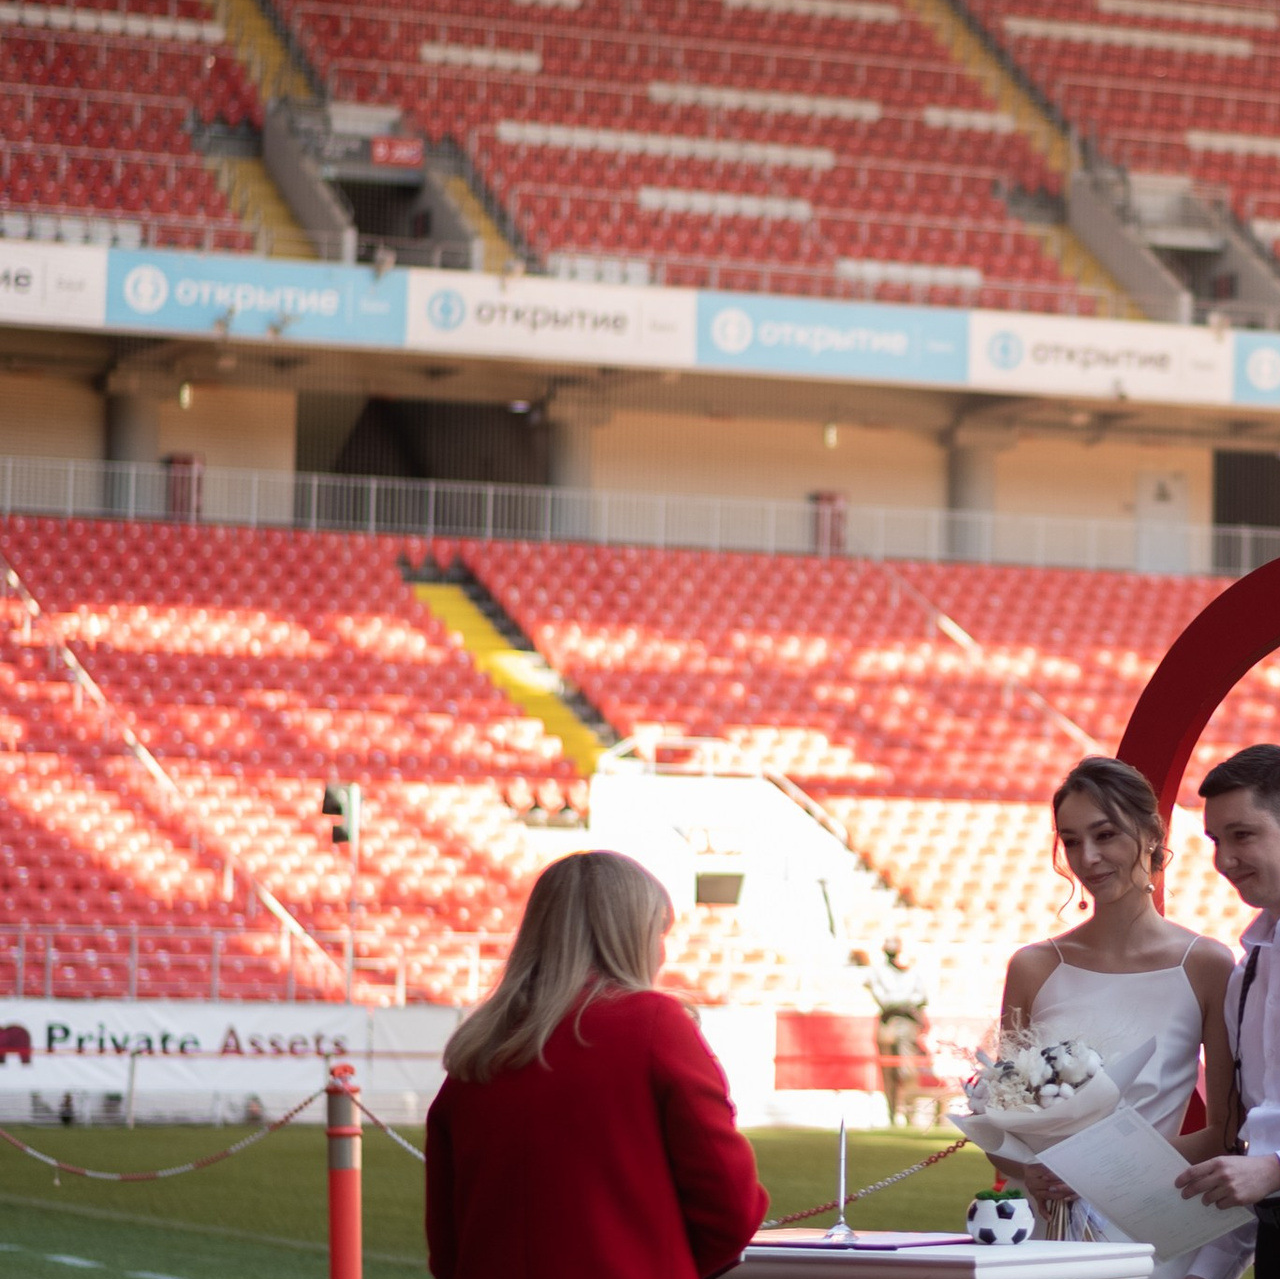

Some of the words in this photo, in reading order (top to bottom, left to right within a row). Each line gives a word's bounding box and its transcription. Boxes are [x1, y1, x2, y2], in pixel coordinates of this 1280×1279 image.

[174, 278, 340, 317] открытие
[475, 302, 629, 336] открытие
[46, 1023, 201, 1055] Private
[219, 1025, 349, 1056] Assets
